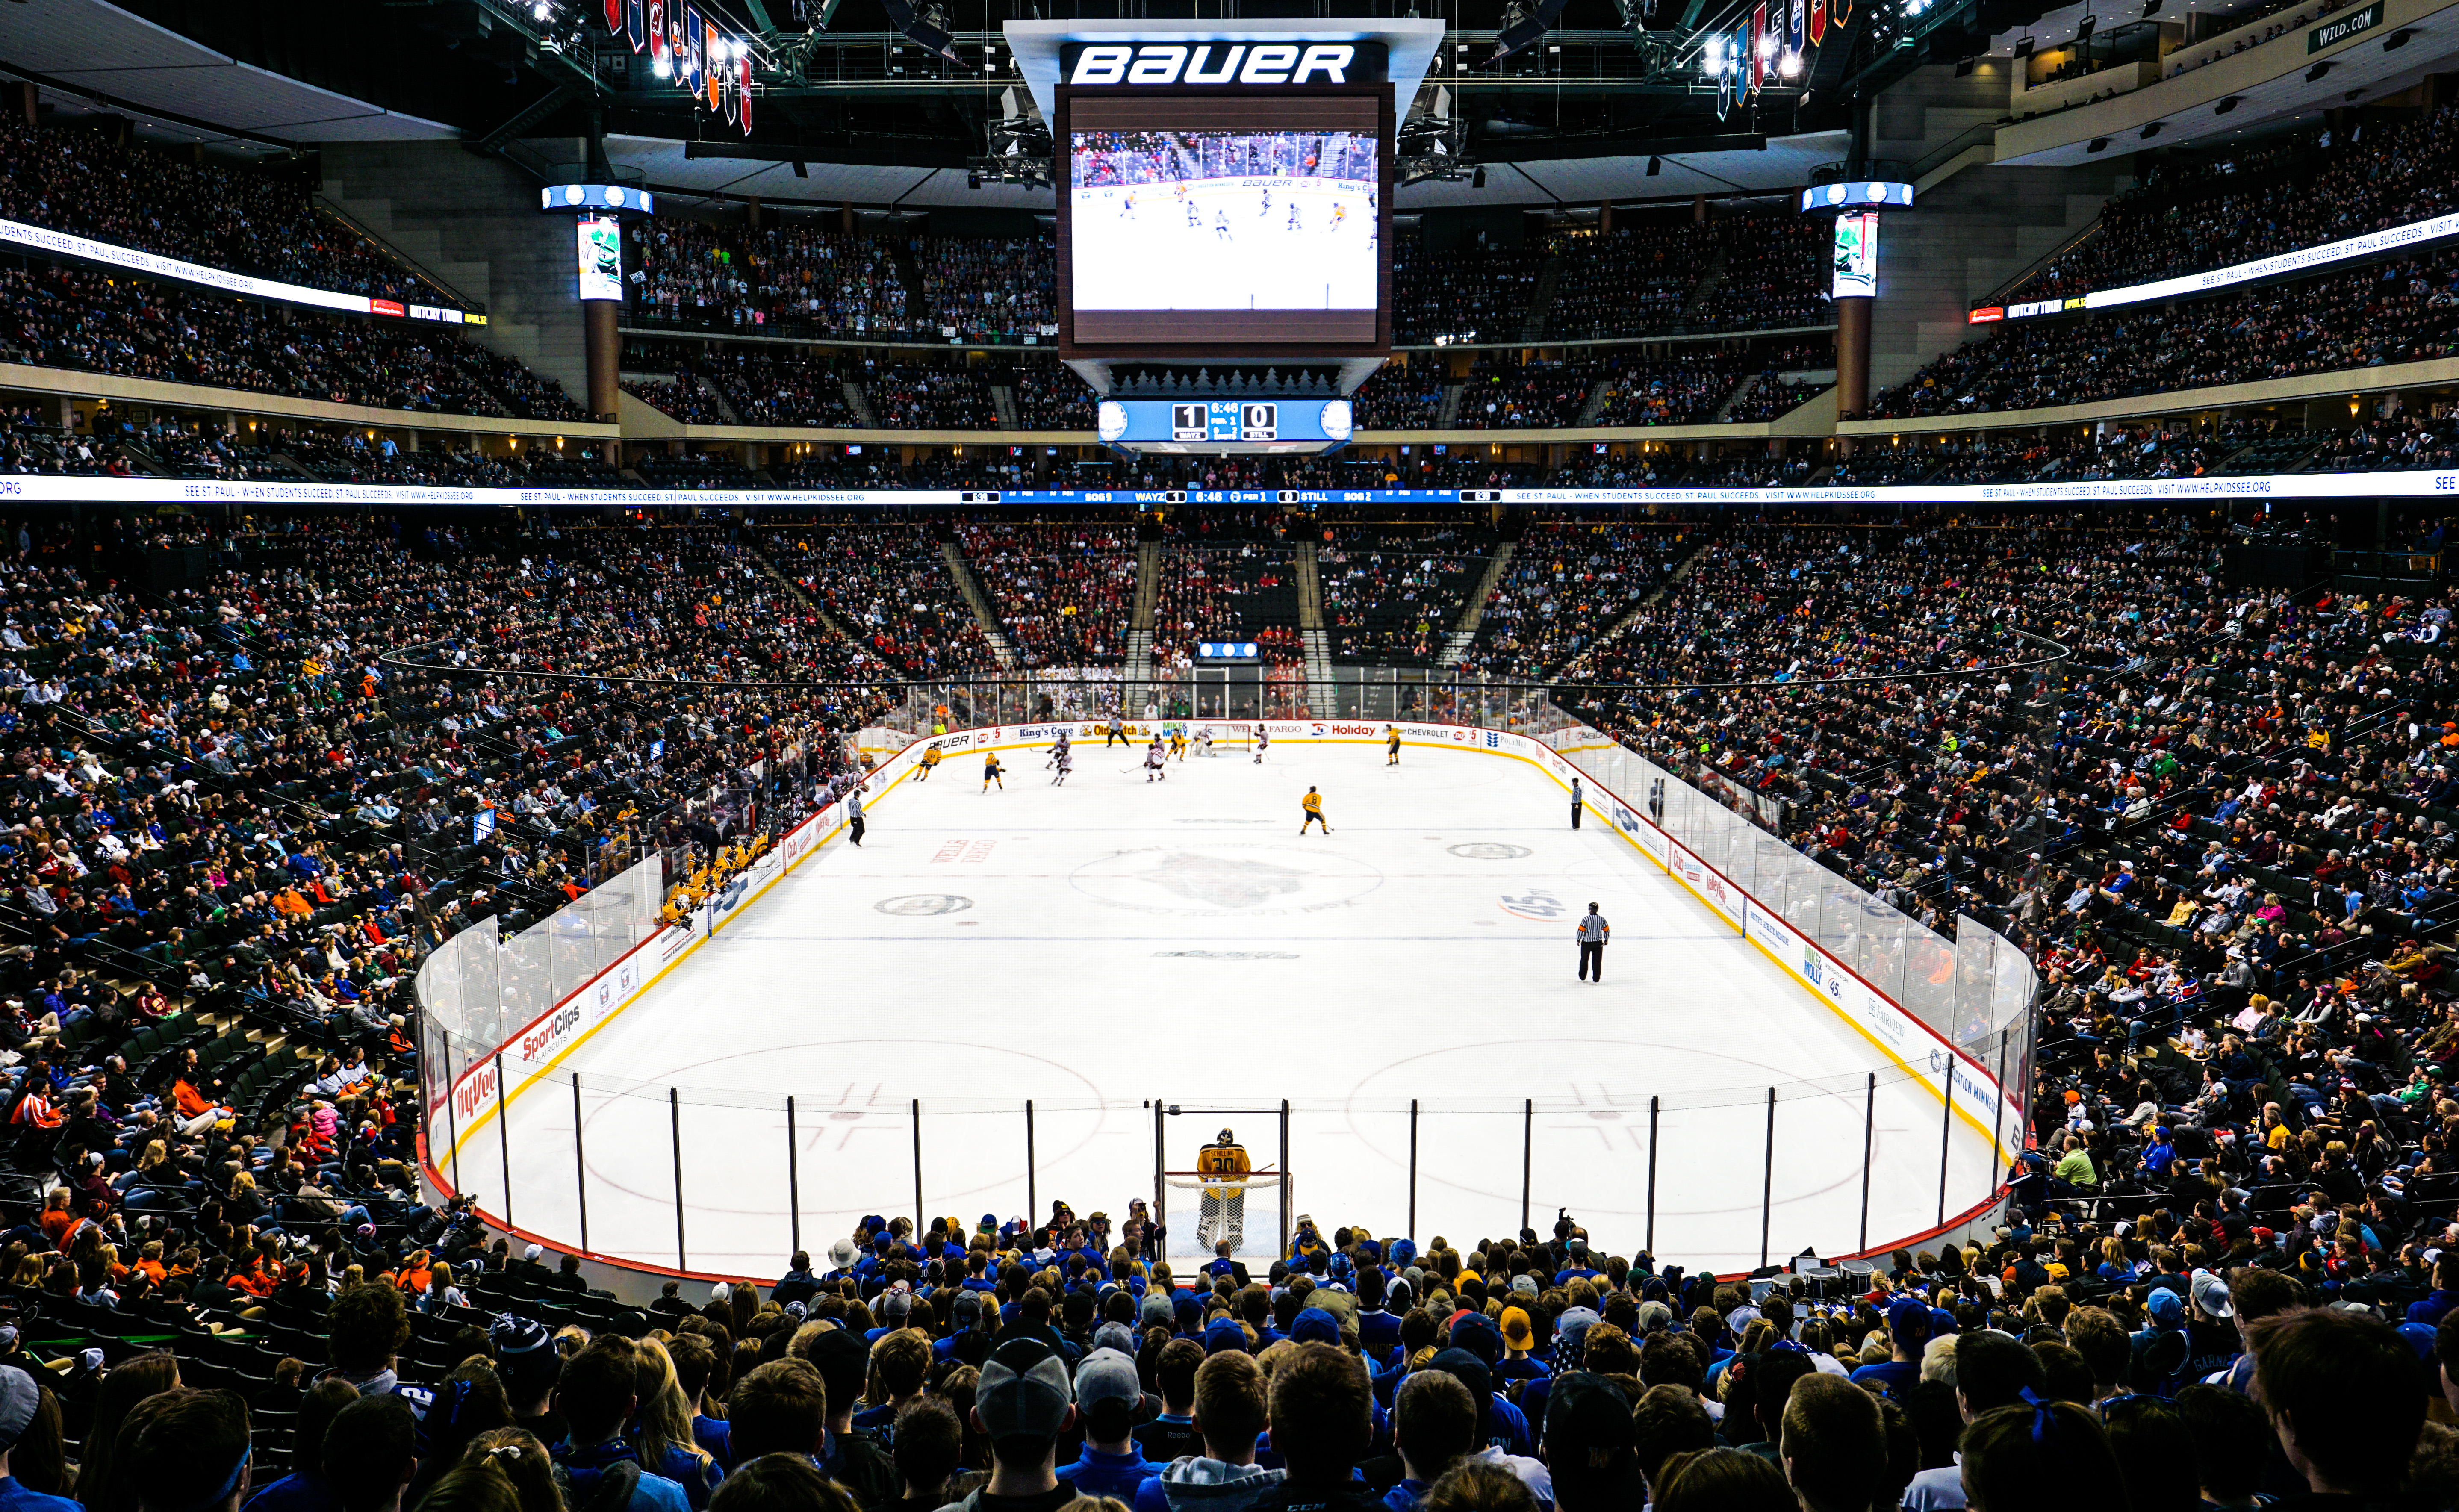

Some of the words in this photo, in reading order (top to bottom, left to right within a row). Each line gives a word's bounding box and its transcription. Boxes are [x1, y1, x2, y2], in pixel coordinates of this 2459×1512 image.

[2320, 7, 2372, 46] WILD.COM
[1070, 45, 1355, 84] BAUER
[1338, 183, 1360, 192] King's
[2202, 275, 2215, 285] SEE
[2227, 270, 2242, 280] PAUL
[2248, 263, 2268, 275] WHEN
[2270, 254, 2305, 270] STUDENTS
[2307, 247, 2342, 262] SUCCEED,
[2345, 243, 2355, 253] ST.
[2358, 238, 2377, 251] PAUL
[2380, 227, 2424, 246] SUCCEEDS.
[2430, 220, 2452, 234] VISIT
[35, 233, 75, 252] SUCCEED,
[77, 242, 87, 253] ST.
[90, 245, 109, 258] PAUL
[112, 251, 151, 267] SUCCEEDS.
[156, 260, 172, 272] VISIT
[174, 265, 254, 290] WWW.HELPKIDSSEE.ORG
[2008, 302, 2040, 318] OUTCRY
[2040, 299, 2062, 314] TOUR
[2064, 299, 2081, 309] APRIL
[409, 304, 441, 321] OUTCRY
[441, 308, 463, 324] TOUR
[464, 313, 479, 324] APRIL
[479, 315, 487, 325] 12
[1211, 402, 1238, 413] 6:46
[1185, 406, 1195, 427] 1
[1230, 416, 1236, 425] 1
[1251, 406, 1267, 427] 0
[2435, 476, 2456, 489] SEE
[185, 486, 200, 496] SEE
[202, 486, 213, 496] ST.
[215, 486, 235, 497] PAUL
[242, 487, 265, 498] WHEN
[267, 487, 302, 498] STUDENTS
[304, 488, 335, 500] SUCCEED,
[336, 489, 345, 498] ST.
[346, 489, 361, 499] PAUL
[363, 489, 394, 500] SUCCEEDS.
[396, 491, 409, 499] VISIT
[411, 491, 473, 500] WWW.HELPKIDSSEE.ORG
[1983, 489, 1993, 497] SEE
[2004, 489, 2016, 497] PAUL
[2020, 488, 2035, 497] WHEN
[2037, 487, 2063, 496] STUDENTS
[2064, 486, 2092, 497] SUCCEED,
[2102, 486, 2118, 495] PAUL
[2119, 485, 2154, 495] SUCCEEDS.
[2158, 484, 2175, 495] VISIT
[2177, 482, 2270, 494] WWW.HELPKIDSSEE.ORG
[521, 492, 532, 501] SEE
[534, 492, 542, 501] ST.
[544, 492, 560, 501] PAUL
[567, 493, 588, 501] WHEN
[590, 493, 626, 501] STUDENTS
[628, 493, 663, 502] SUCCEED,
[1085, 493, 1106, 501] SOG
[1106, 493, 1112, 502] 9
[1135, 492, 1165, 501] WAYZ
[1173, 492, 1179, 501] 1
[1196, 492, 1222, 502] 6:46
[1260, 492, 1266, 502] 1
[1285, 492, 1293, 501] 0
[1301, 492, 1328, 501] STILL
[1344, 492, 1364, 501] SOG
[1365, 492, 1371, 501] 2
[1645, 492, 1683, 501] SUCCEED,
[1020, 728, 1048, 738] King's
[1051, 726, 1073, 735] Cove
[1094, 725, 1109, 735] Old
[1332, 725, 1376, 736] Holiday
[1407, 728, 1449, 738] CHEVROLET
[1311, 796, 1317, 804] 8
[788, 839, 797, 859] Cub
[1674, 849, 1684, 872] Cub
[1804, 959, 1822, 987] MOLLY
[1830, 980, 1840, 997] 45
[1877, 1005, 1906, 1037] FAIRVIEW
[523, 1005, 580, 1061] SportClips
[535, 1034, 568, 1064] HAIRCUTS
[1974, 1084, 1998, 1119] MINNESOT
[1213, 1157, 1234, 1172] 30
[2194, 1354, 2231, 1372] GARNE
[1287, 1502, 1327, 1512] CCM
